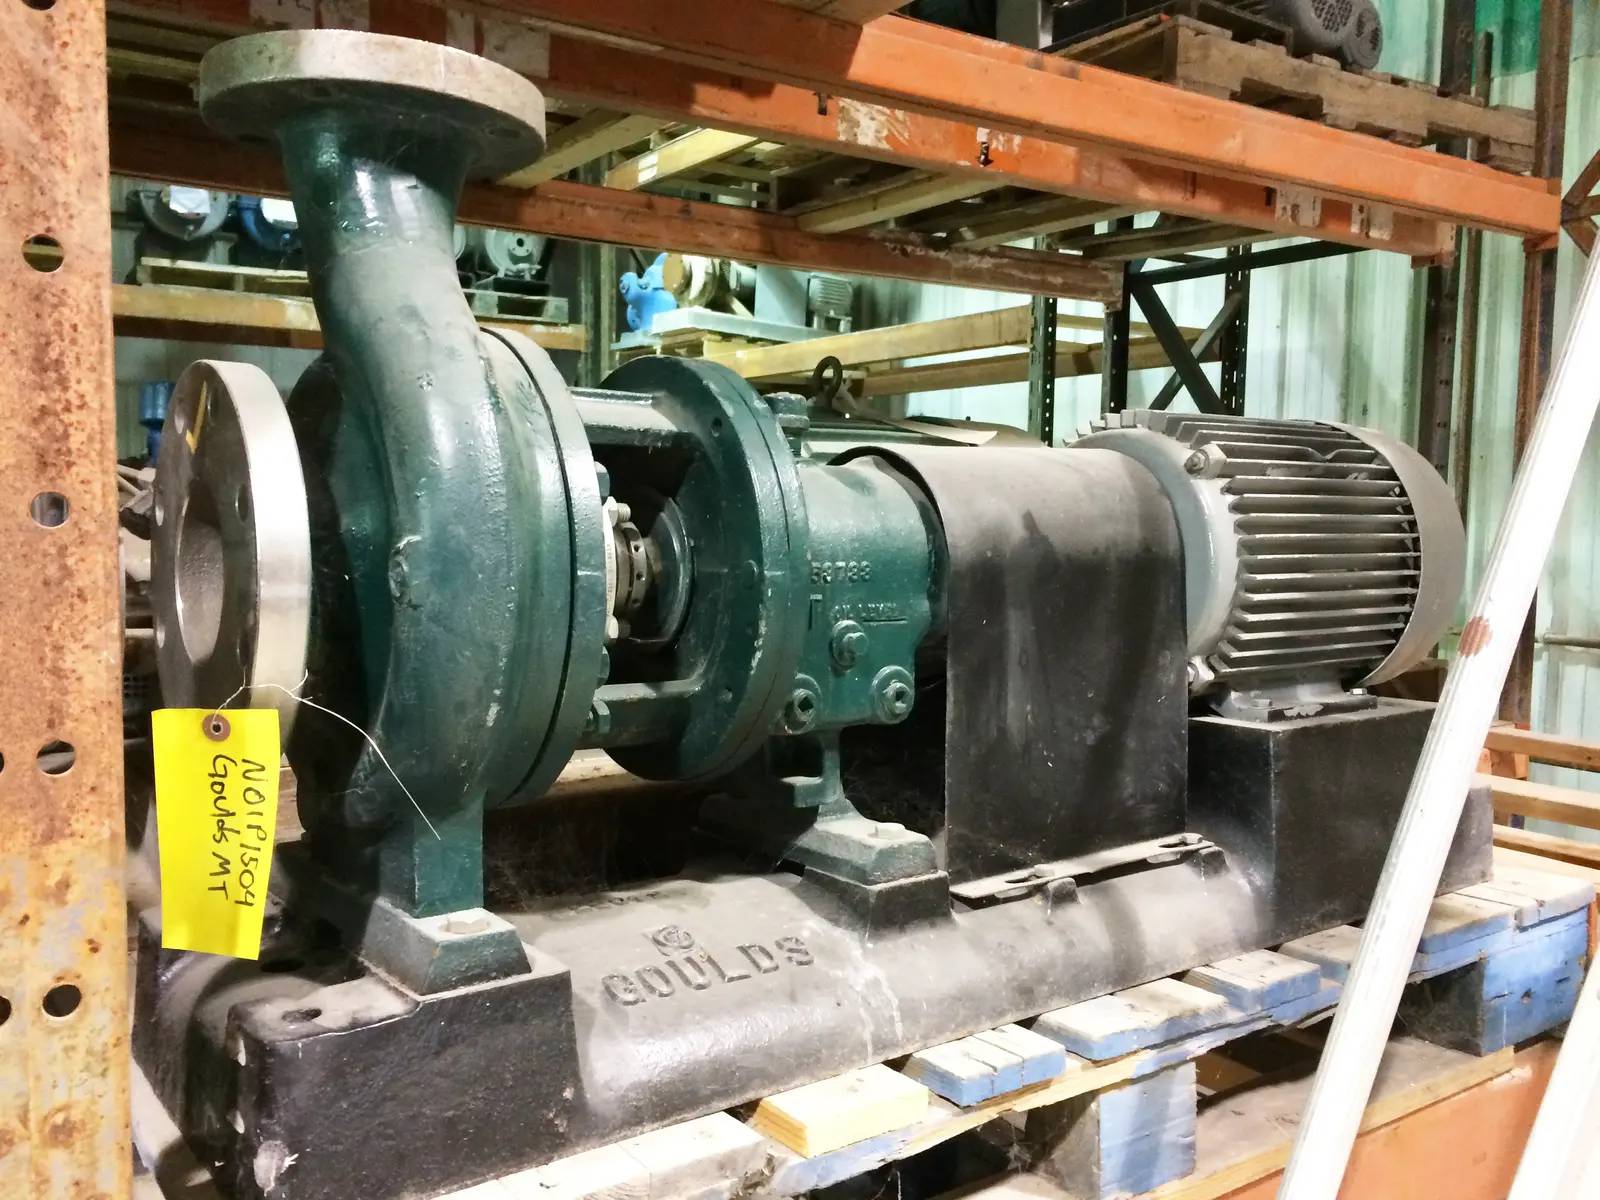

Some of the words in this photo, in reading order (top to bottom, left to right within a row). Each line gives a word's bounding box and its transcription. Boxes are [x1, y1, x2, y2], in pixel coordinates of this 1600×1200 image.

[207, 753, 241, 844] Goulds
[207, 850, 232, 901] MT
[600, 936, 815, 1007] GOULDS
